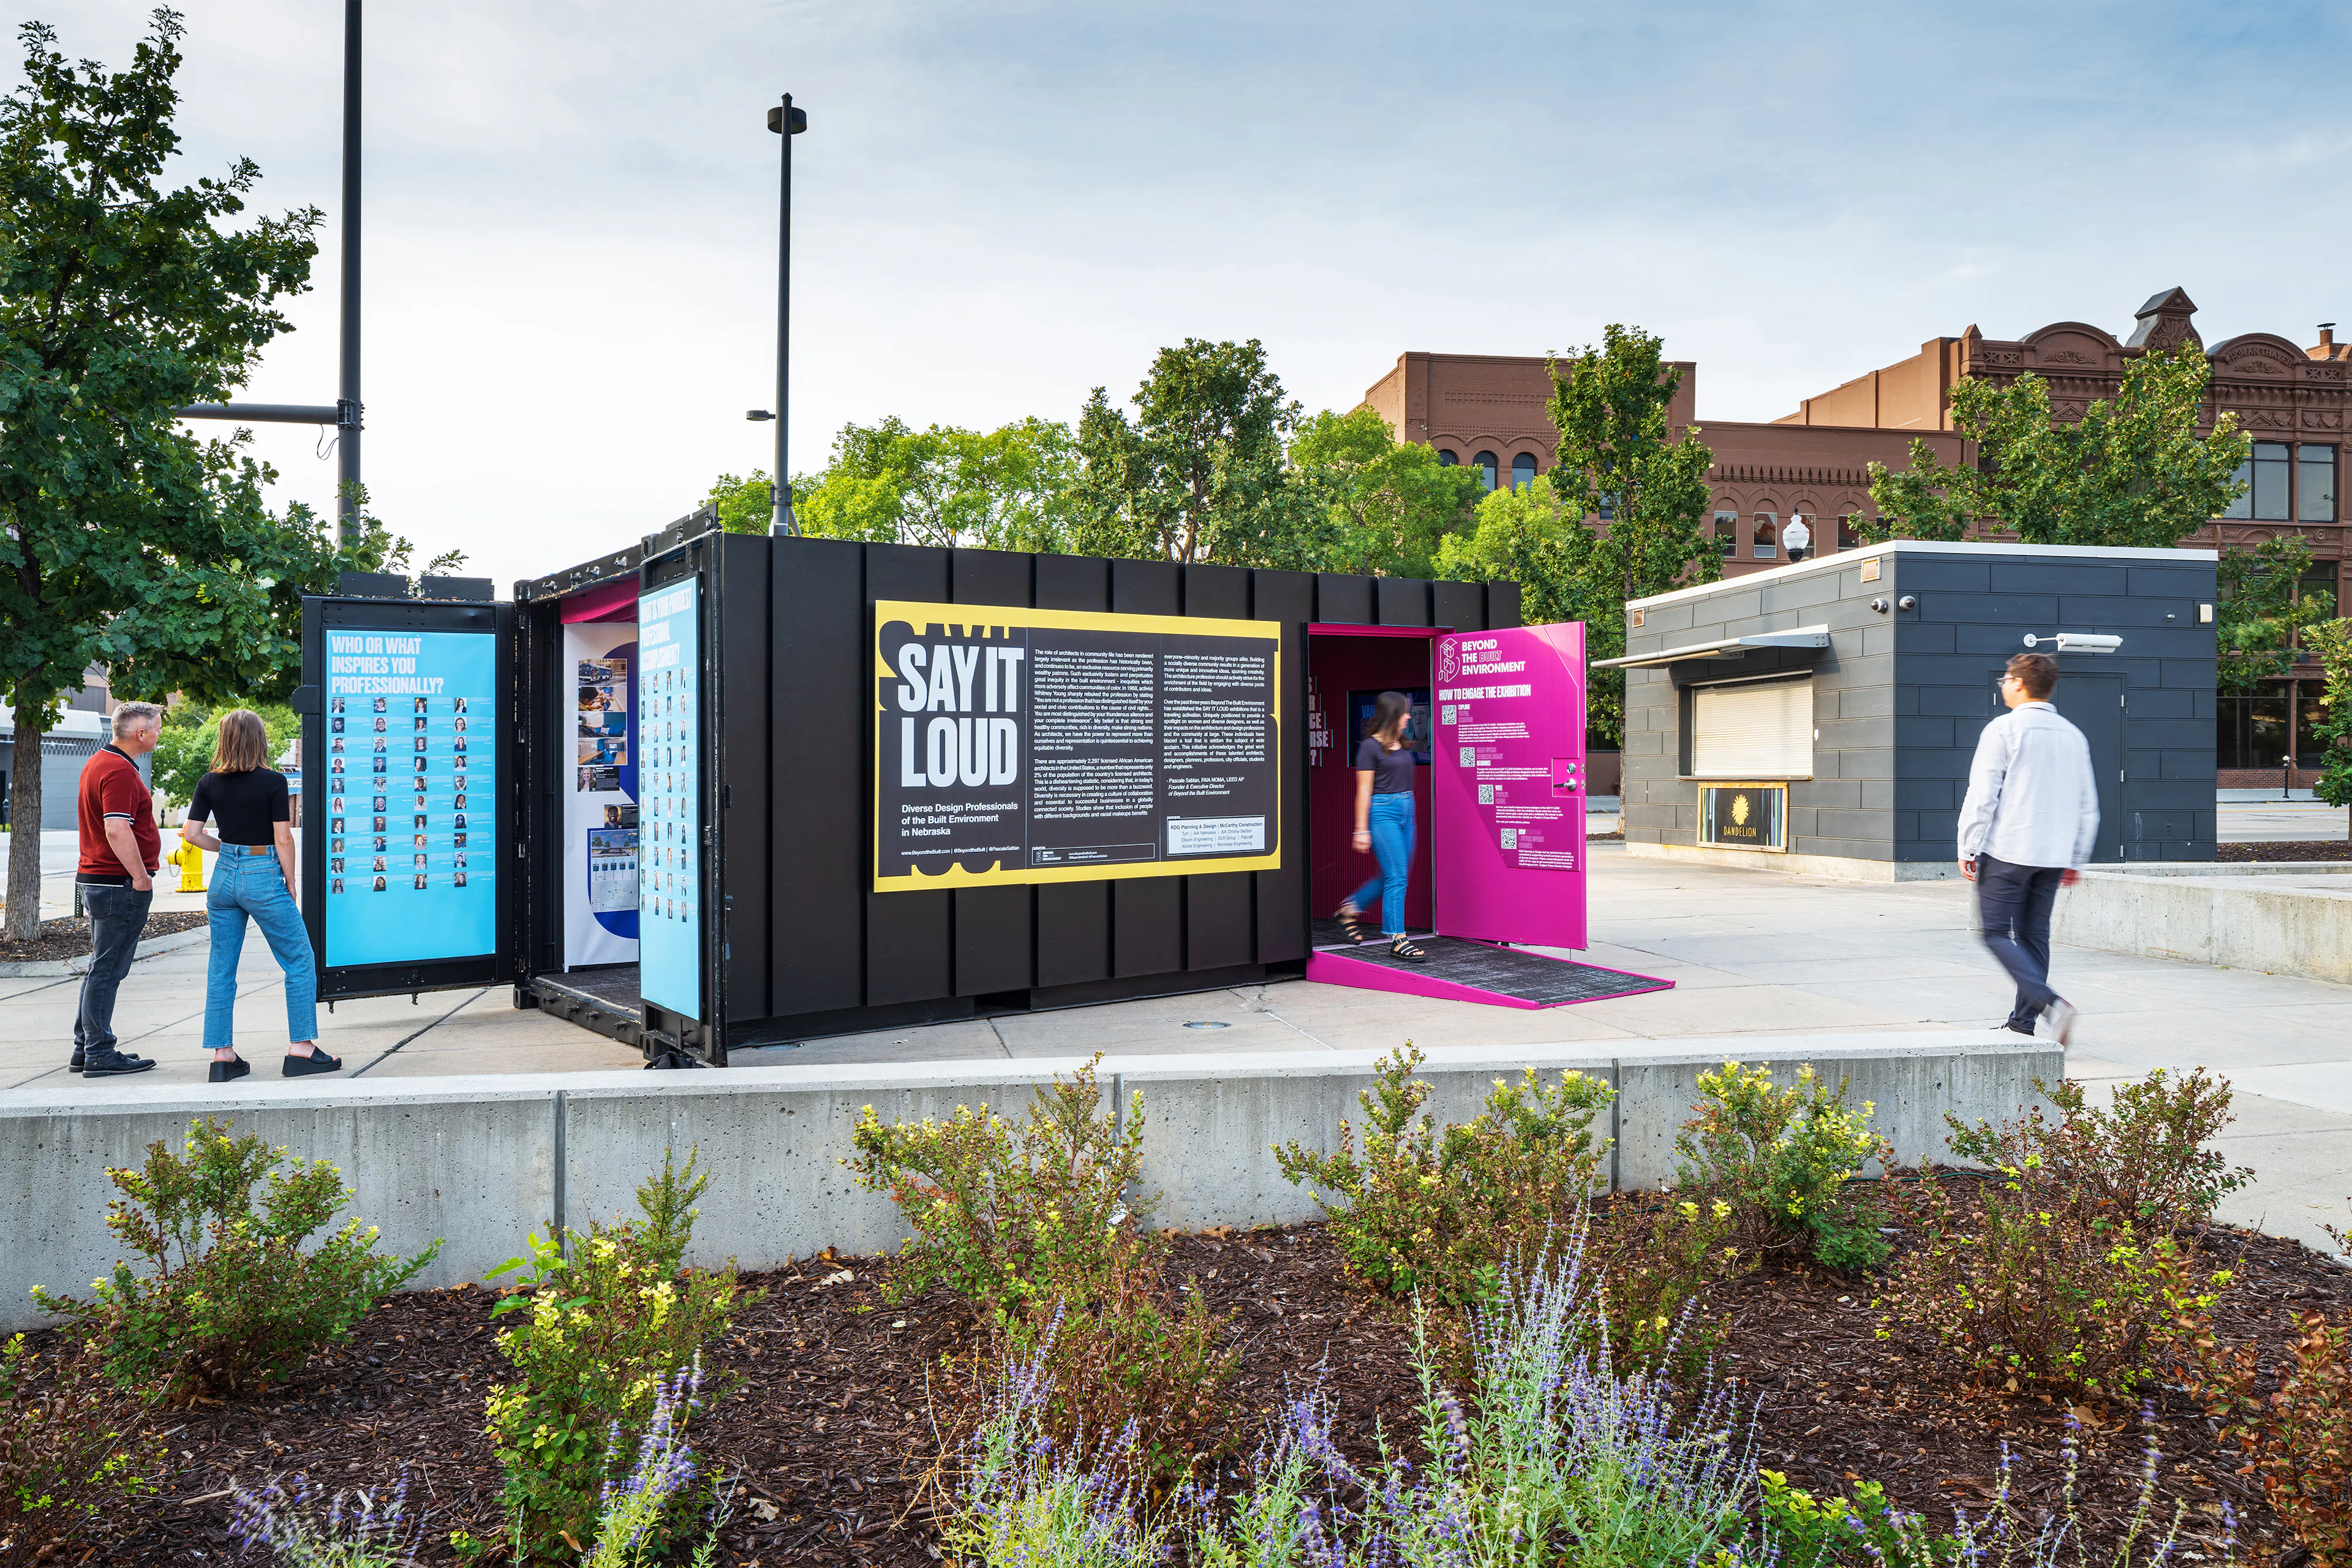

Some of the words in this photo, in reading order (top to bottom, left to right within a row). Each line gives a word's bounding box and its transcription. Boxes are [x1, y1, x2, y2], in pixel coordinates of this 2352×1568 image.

[641, 601, 652, 624] WHAT
[652, 600, 657, 621] IS
[657, 595, 668, 619] YOUR
[669, 587, 692, 616] PROUDEST
[641, 620, 670, 648] PROFESSIONAL
[331, 636, 363, 654] WHO
[366, 636, 383, 654] OR
[385, 637, 421, 654] WHAT
[1462, 639, 1497, 652] BEYOND
[641, 643, 680, 672] ACCOMPLISHMENT?
[1461, 652, 1477, 663] THE
[1479, 650, 1502, 663] BUILT
[332, 657, 389, 674] INSPIRES
[391, 657, 416, 674] YOU
[1462, 661, 1525, 675] ENVIRONMENT
[332, 676, 444, 694] PROFESSIONALLY?
[898, 643, 979, 712] SAY
[986, 647, 1024, 712] IT
[1439, 689, 1453, 701] HOW
[1454, 688, 1461, 700] TO
[1462, 687, 1484, 699] ENGAGE
[1485, 686, 1496, 698] THE
[1497, 684, 1531, 698] EXHIBITION
[902, 717, 1017, 787] LOUD
[935, 804, 963, 813] Design
[965, 802, 1018, 812] Professionals
[928, 815, 947, 824] Built
[949, 814, 999, 823] Environment
[912, 827, 951, 836] Nebraska
[1724, 826, 1756, 837] DANDELION
